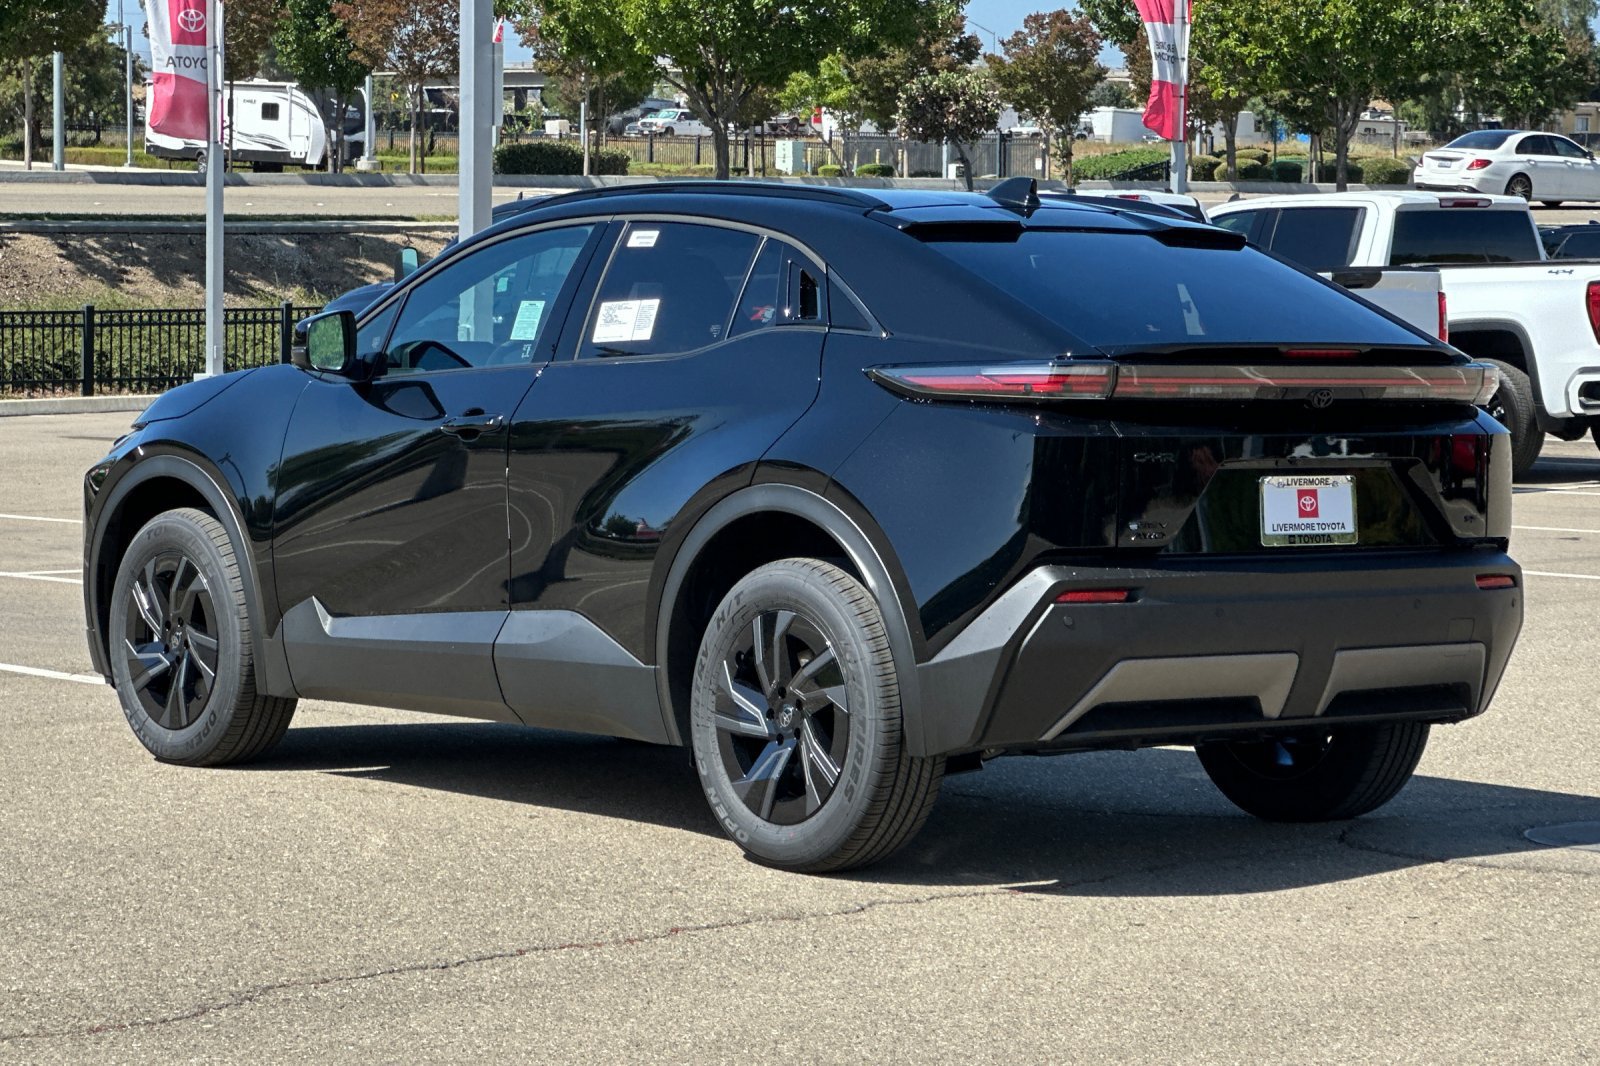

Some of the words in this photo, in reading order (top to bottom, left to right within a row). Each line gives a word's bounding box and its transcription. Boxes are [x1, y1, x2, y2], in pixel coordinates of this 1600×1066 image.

[1286, 478, 1329, 486] LIVERMORE
[1272, 523, 1315, 532] LIVERMORE
[1317, 522, 1346, 531] TOYOTA
[1299, 534, 1332, 543] TOYOTA
[705, 786, 749, 843] OPEN
